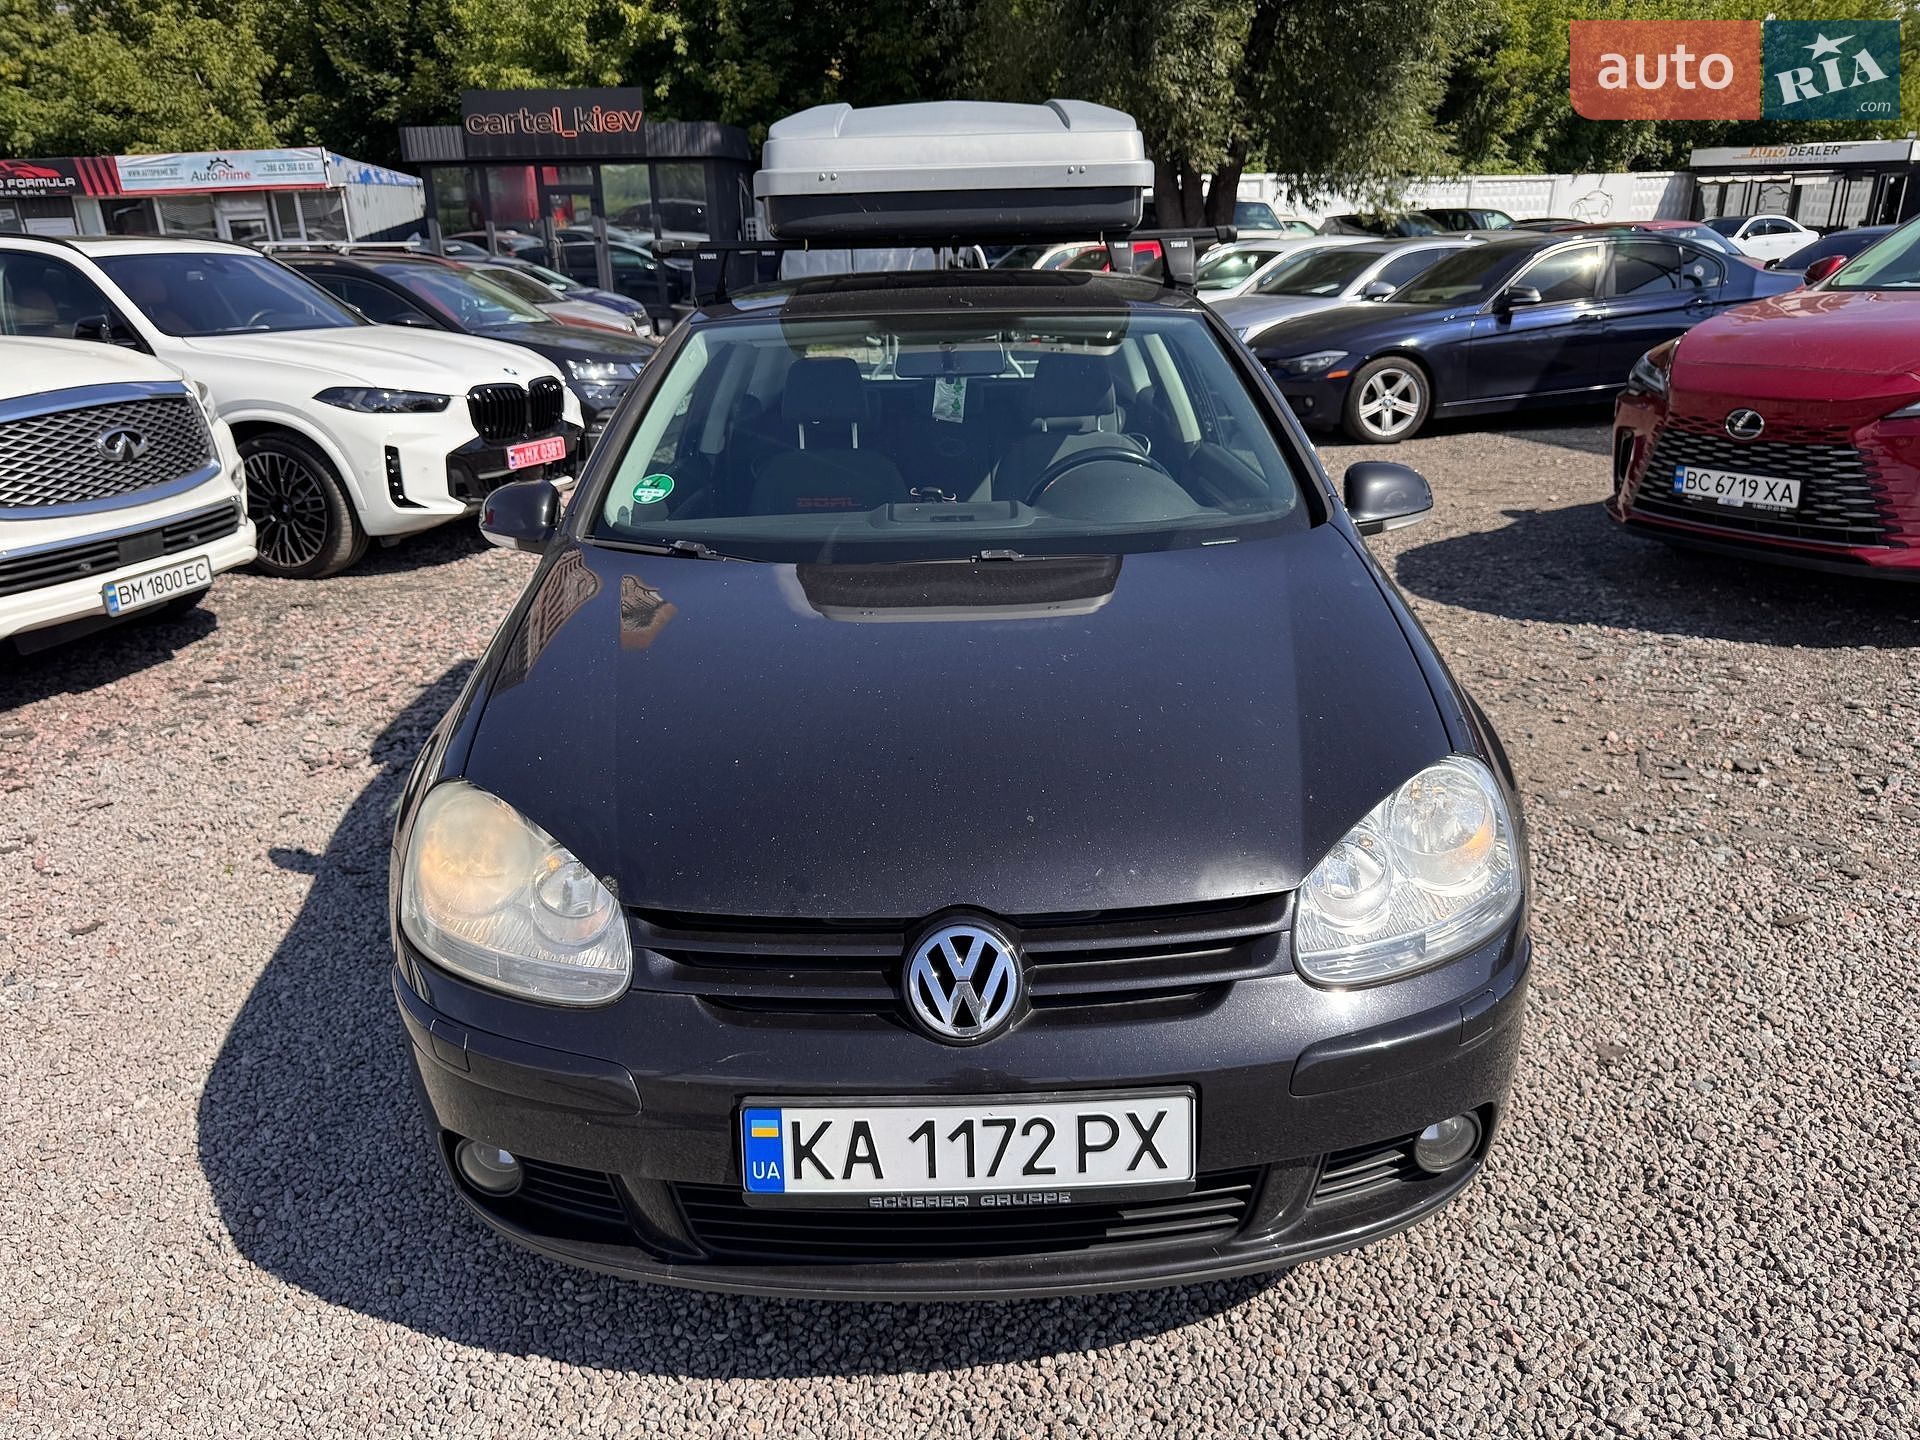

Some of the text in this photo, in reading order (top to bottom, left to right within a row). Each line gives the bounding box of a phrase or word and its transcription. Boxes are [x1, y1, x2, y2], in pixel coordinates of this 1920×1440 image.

[465, 105, 643, 138] cartel_kiev
[6, 177, 76, 188] FORMULA
[191, 169, 250, 182] AutoPrime
[1686, 471, 1793, 503] BC 6719 XA
[118, 563, 207, 605] BM 1800 EC
[790, 1110, 1168, 1180] KA 1172 PX
[753, 1161, 780, 1179] UA
[868, 1191, 1072, 1209] SCHERER GRUPPE
